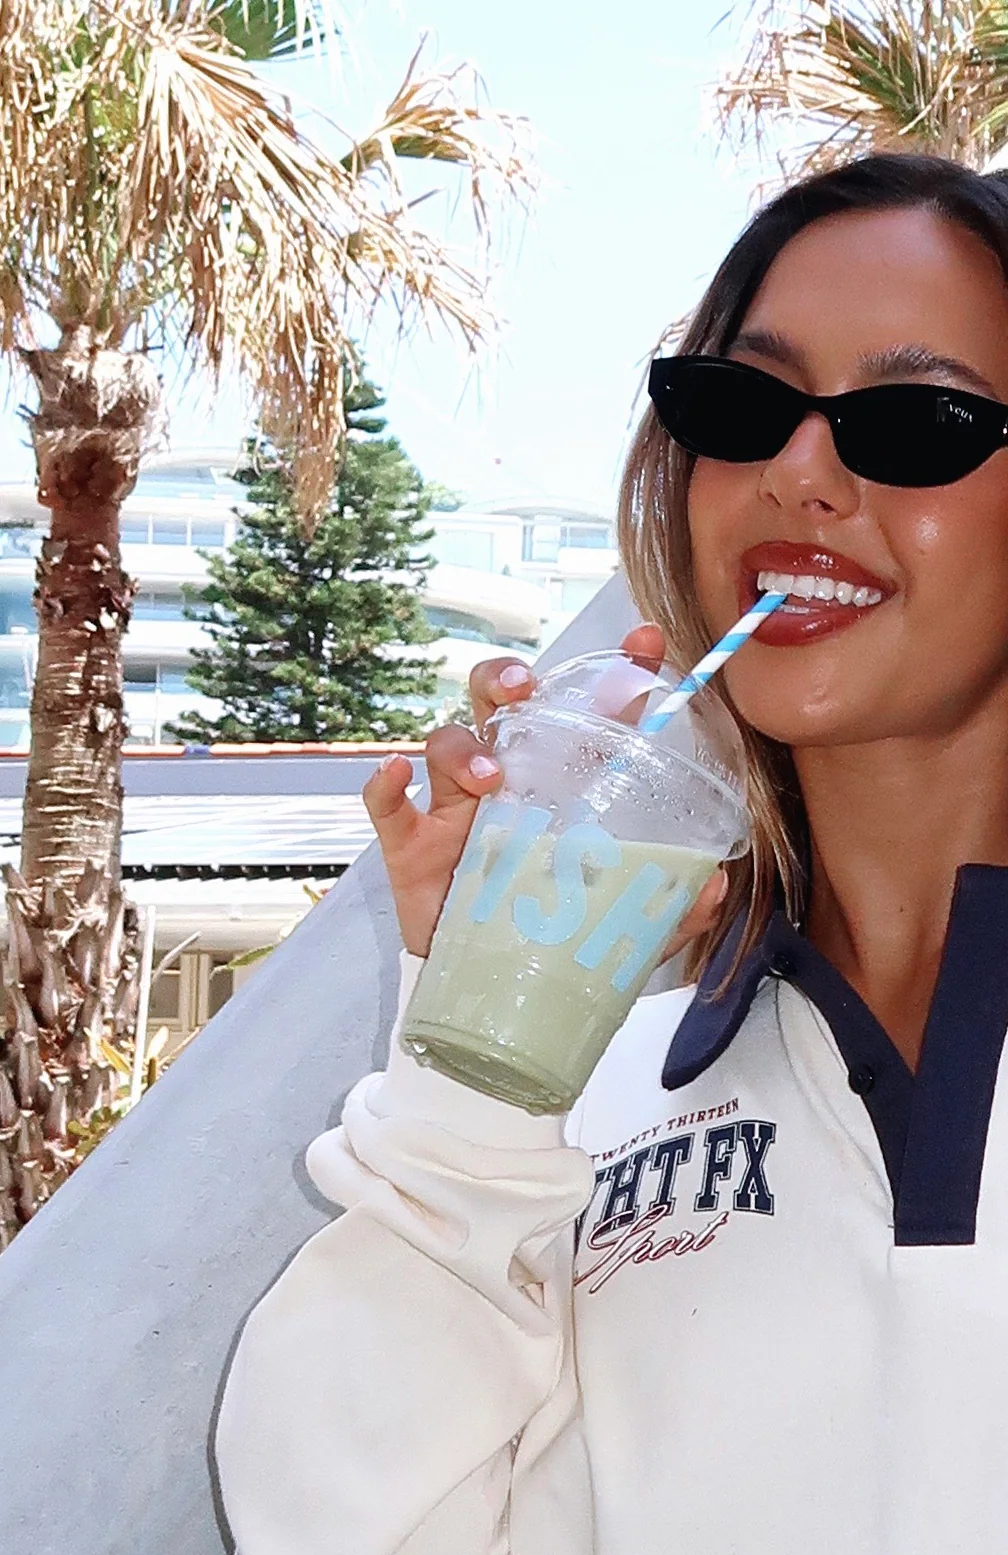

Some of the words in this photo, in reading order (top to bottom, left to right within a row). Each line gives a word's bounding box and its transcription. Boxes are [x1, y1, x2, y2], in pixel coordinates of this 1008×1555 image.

[590, 1124, 662, 1162] TWENTY
[667, 1098, 739, 1132] THIRTEEN
[694, 1119, 777, 1216] FX
[574, 1204, 730, 1294] Sport
